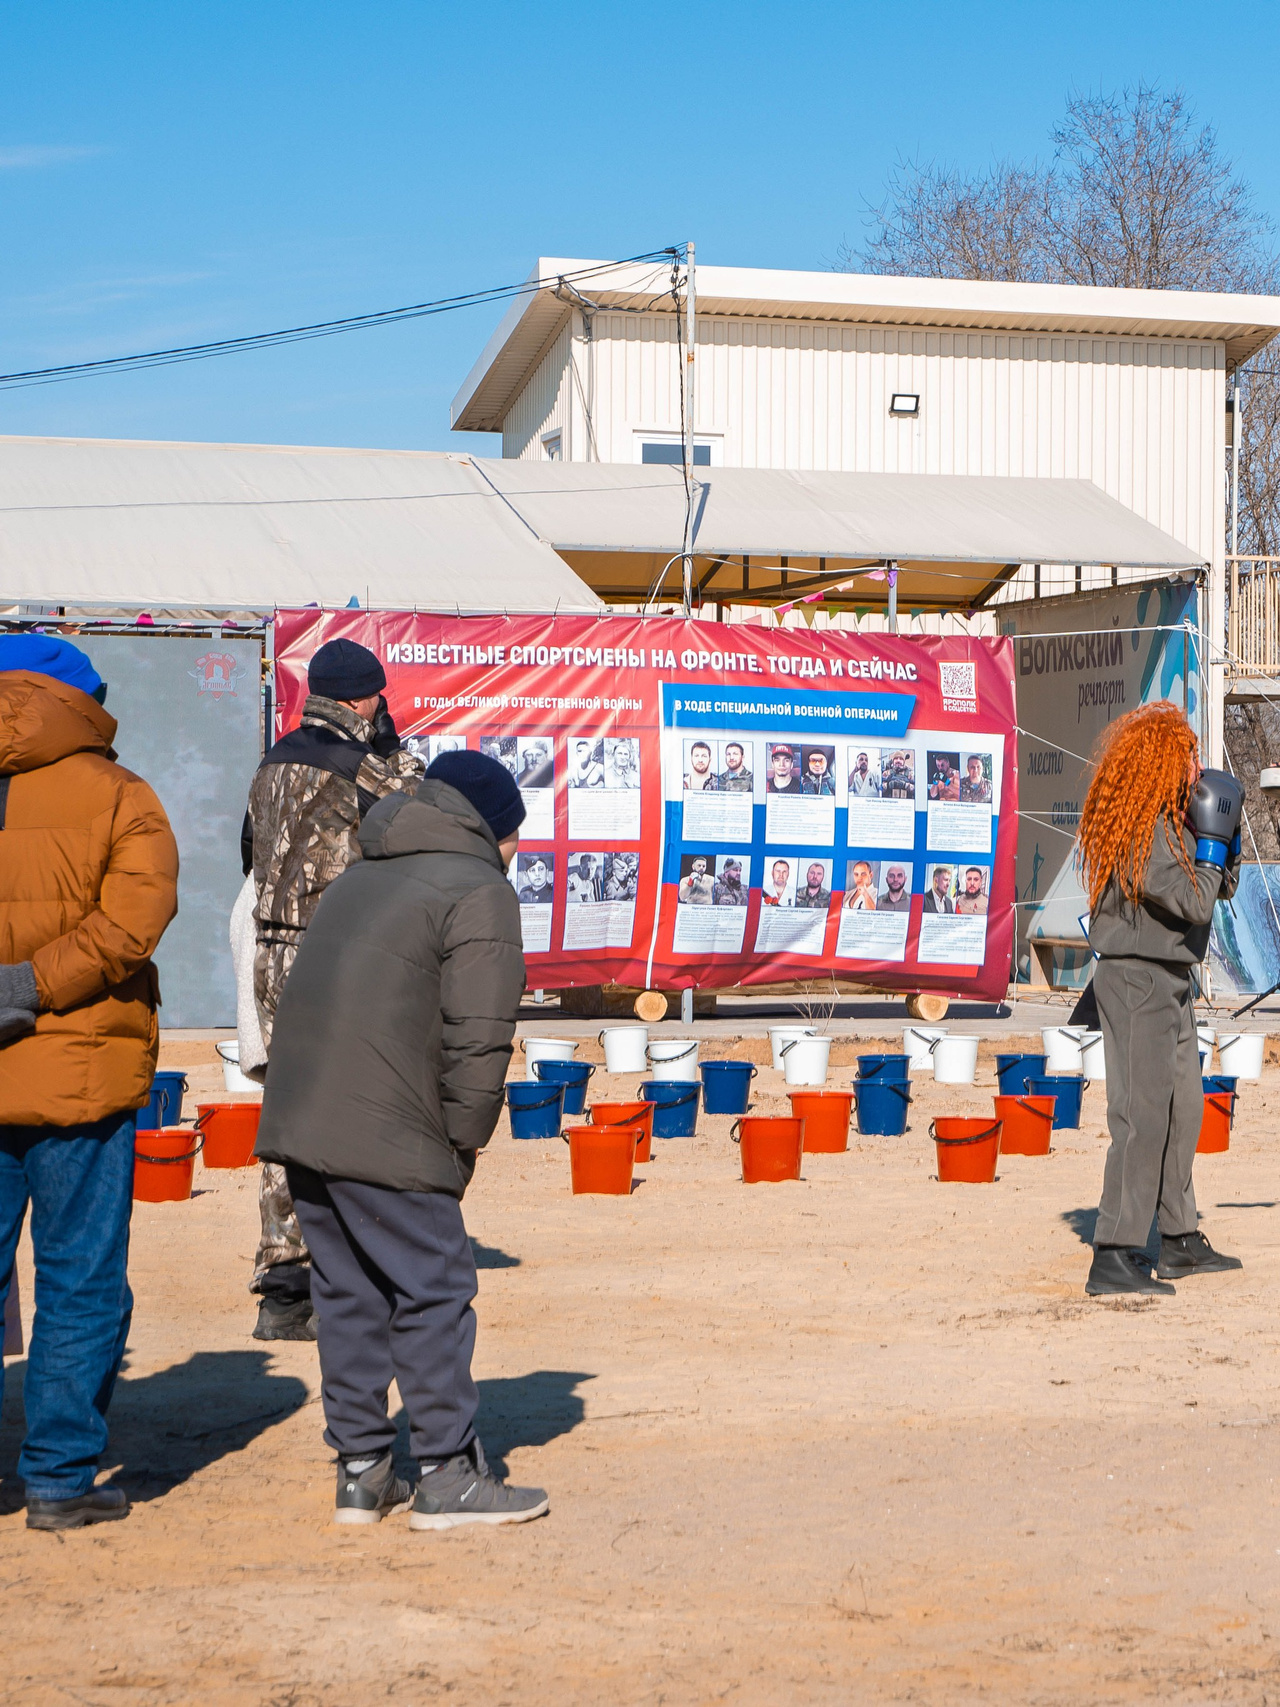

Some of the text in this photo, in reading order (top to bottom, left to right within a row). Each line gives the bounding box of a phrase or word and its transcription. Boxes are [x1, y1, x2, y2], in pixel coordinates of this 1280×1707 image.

[1019, 615, 1123, 676] Волжский
[386, 643, 918, 681] ИЗВЕСТНЫЕ СПОРТСМЕНЫ НА ФРОНТЕ. ТОГДА И СЕЙЧАС
[414, 694, 642, 710] В ГОДЫ ВЕЛИКОЙ ОТЕЧЕСТВЕННОЙ ВОЙНЫ
[674, 699, 898, 721] В ХОДЕ СПЕЦИАЛЬНОЙ ВОЕННОЙ ОПЕРАЦИИ
[942, 698, 977, 708] ЯРОПОЛК
[1077, 679, 1126, 724] речпорт
[1027, 751, 1064, 776] место
